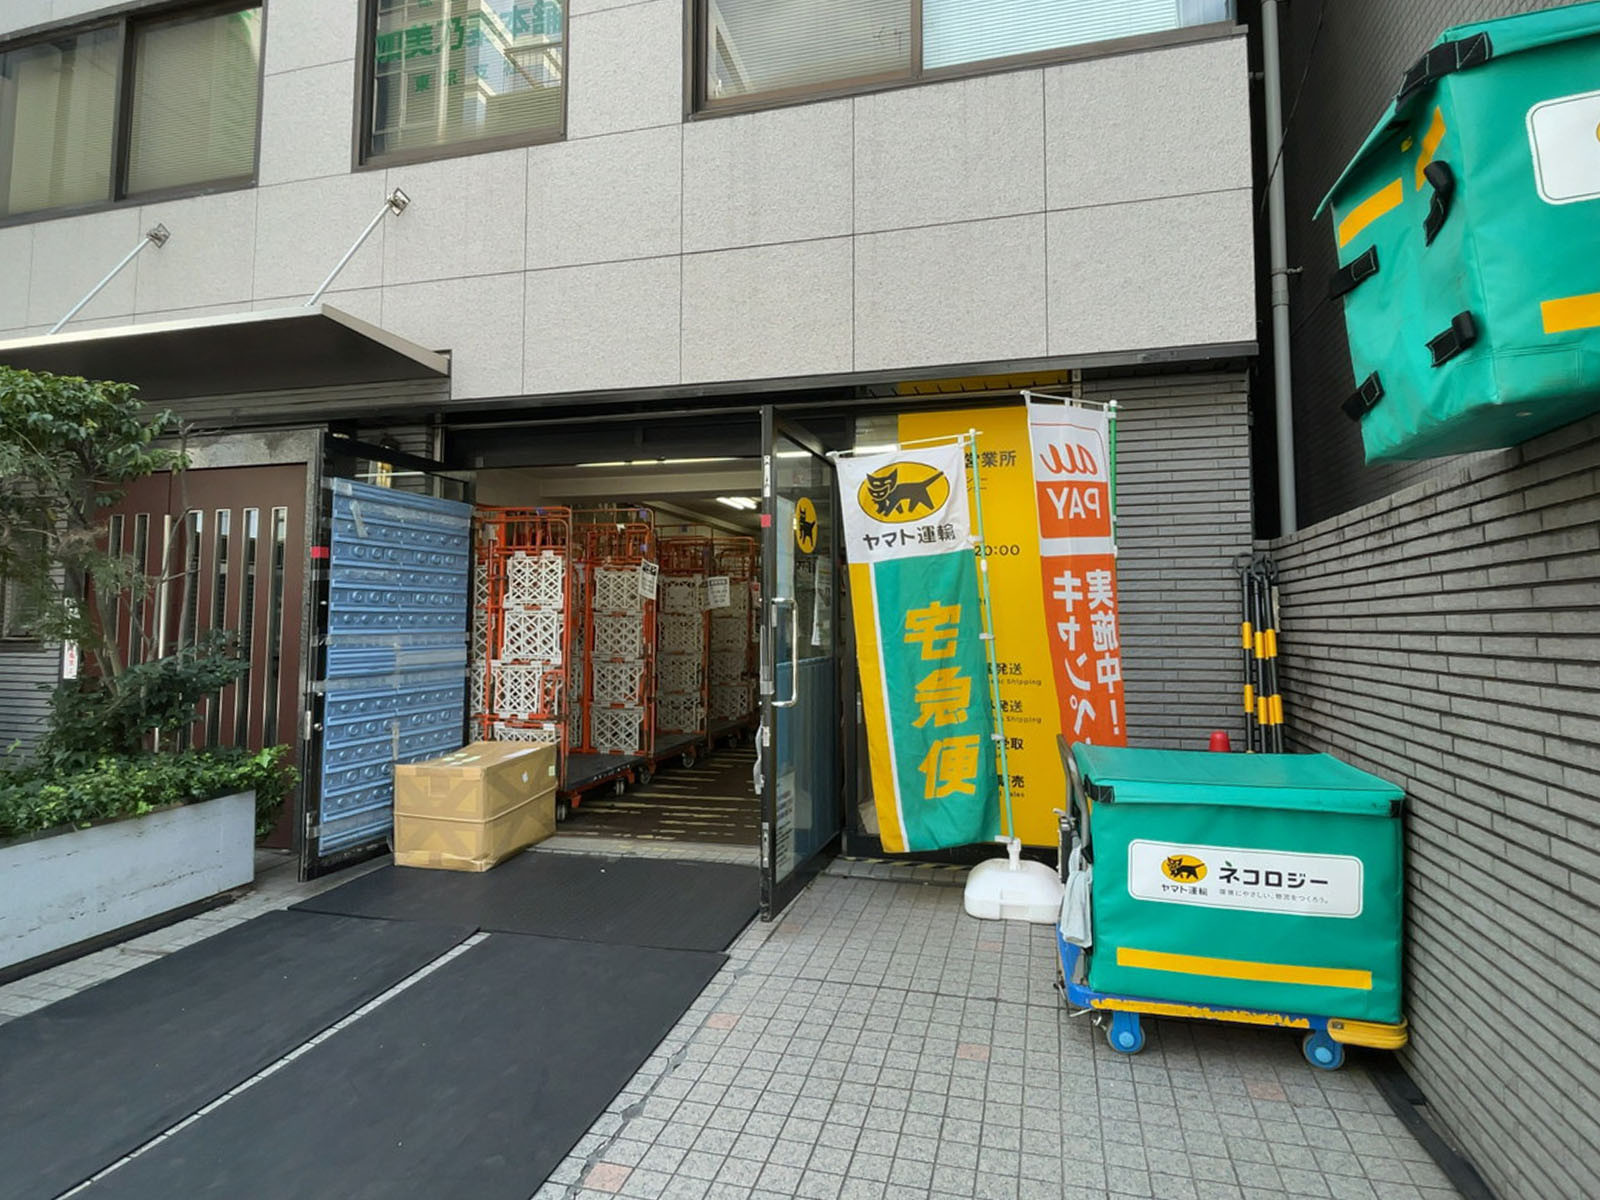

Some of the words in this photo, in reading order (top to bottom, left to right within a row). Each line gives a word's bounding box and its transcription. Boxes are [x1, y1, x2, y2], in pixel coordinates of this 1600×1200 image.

[862, 523, 956, 551] ヤマト運輸
[974, 544, 1021, 557] 20:00
[903, 600, 981, 800] 宅急便
[991, 700, 1023, 712] 発送
[1218, 861, 1329, 889] ネコロジー
